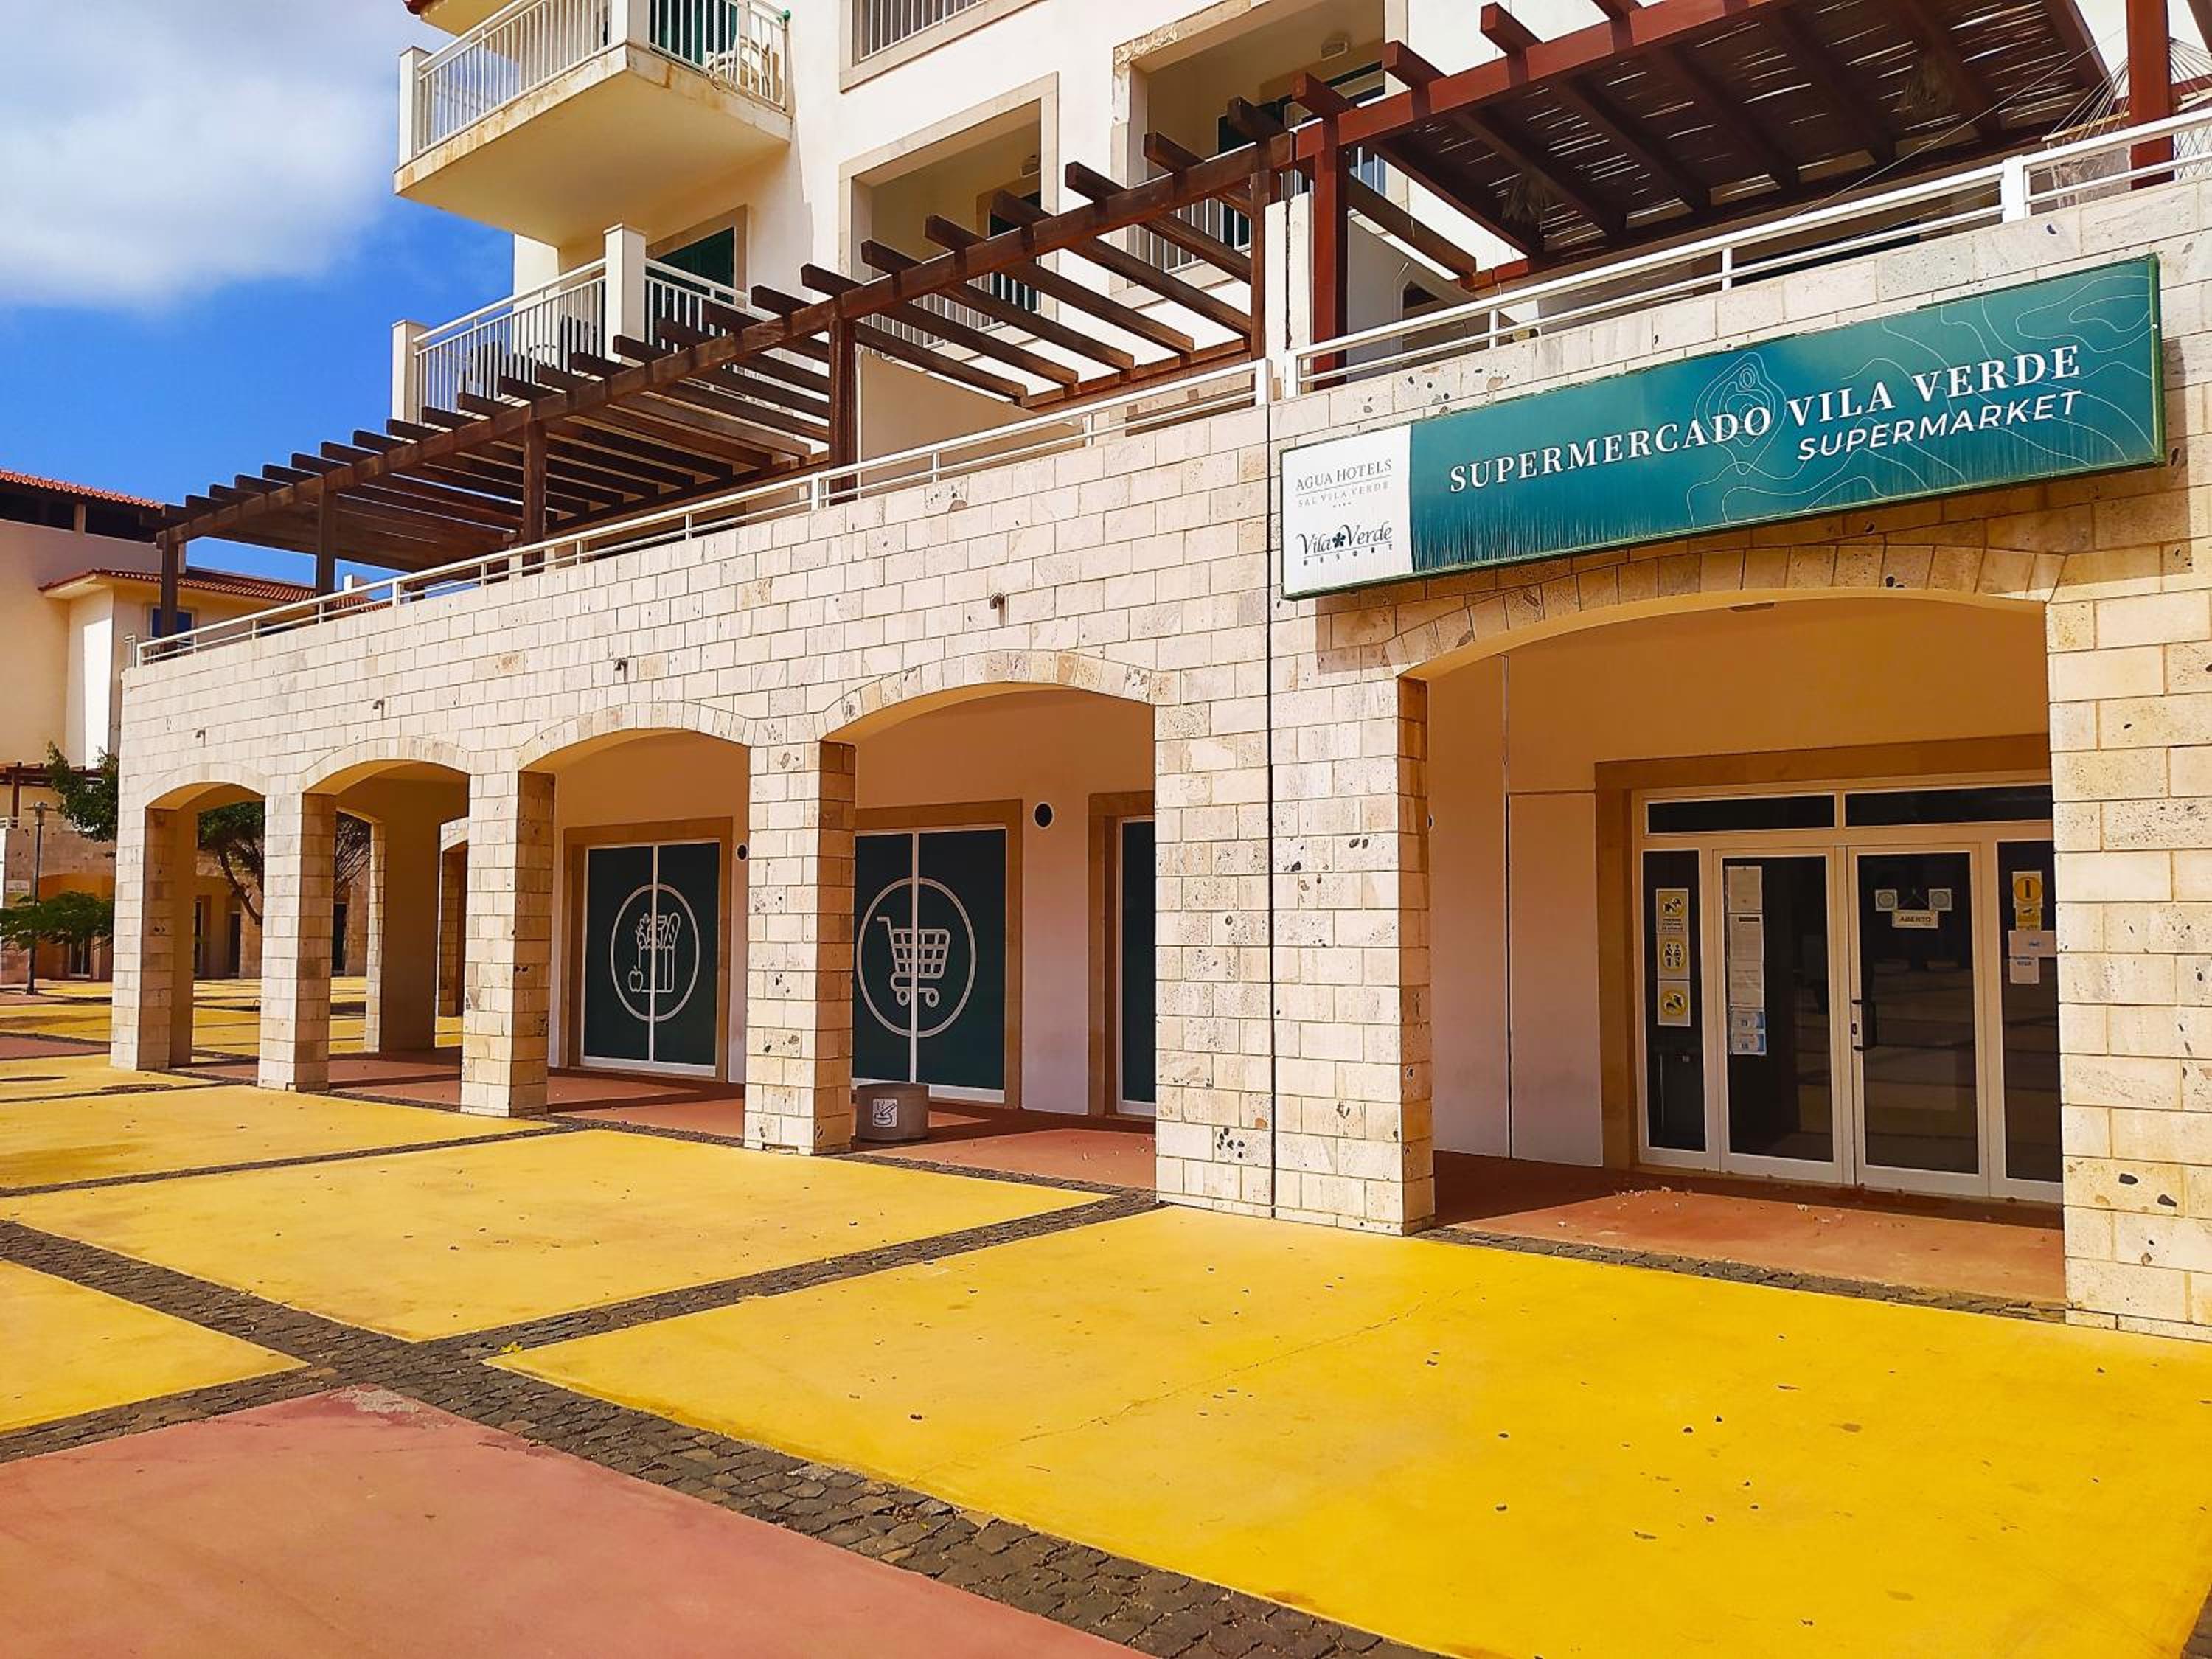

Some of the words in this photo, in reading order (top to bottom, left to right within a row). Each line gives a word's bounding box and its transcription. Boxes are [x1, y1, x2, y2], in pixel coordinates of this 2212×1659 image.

[1450, 406, 1772, 493] SUPERMERCADO
[1786, 380, 1896, 428] VILA
[1913, 344, 2081, 403] VERDE
[1797, 389, 2082, 462] SUPERMARKET
[1296, 473, 1332, 491] AGUA
[1336, 459, 1392, 482] HOTELS
[1298, 498, 1316, 508] SAL
[1320, 491, 1347, 503] VILA
[1351, 481, 1388, 495] VERDE
[1295, 532, 1333, 555] Vila
[1338, 520, 1392, 546] Verde
